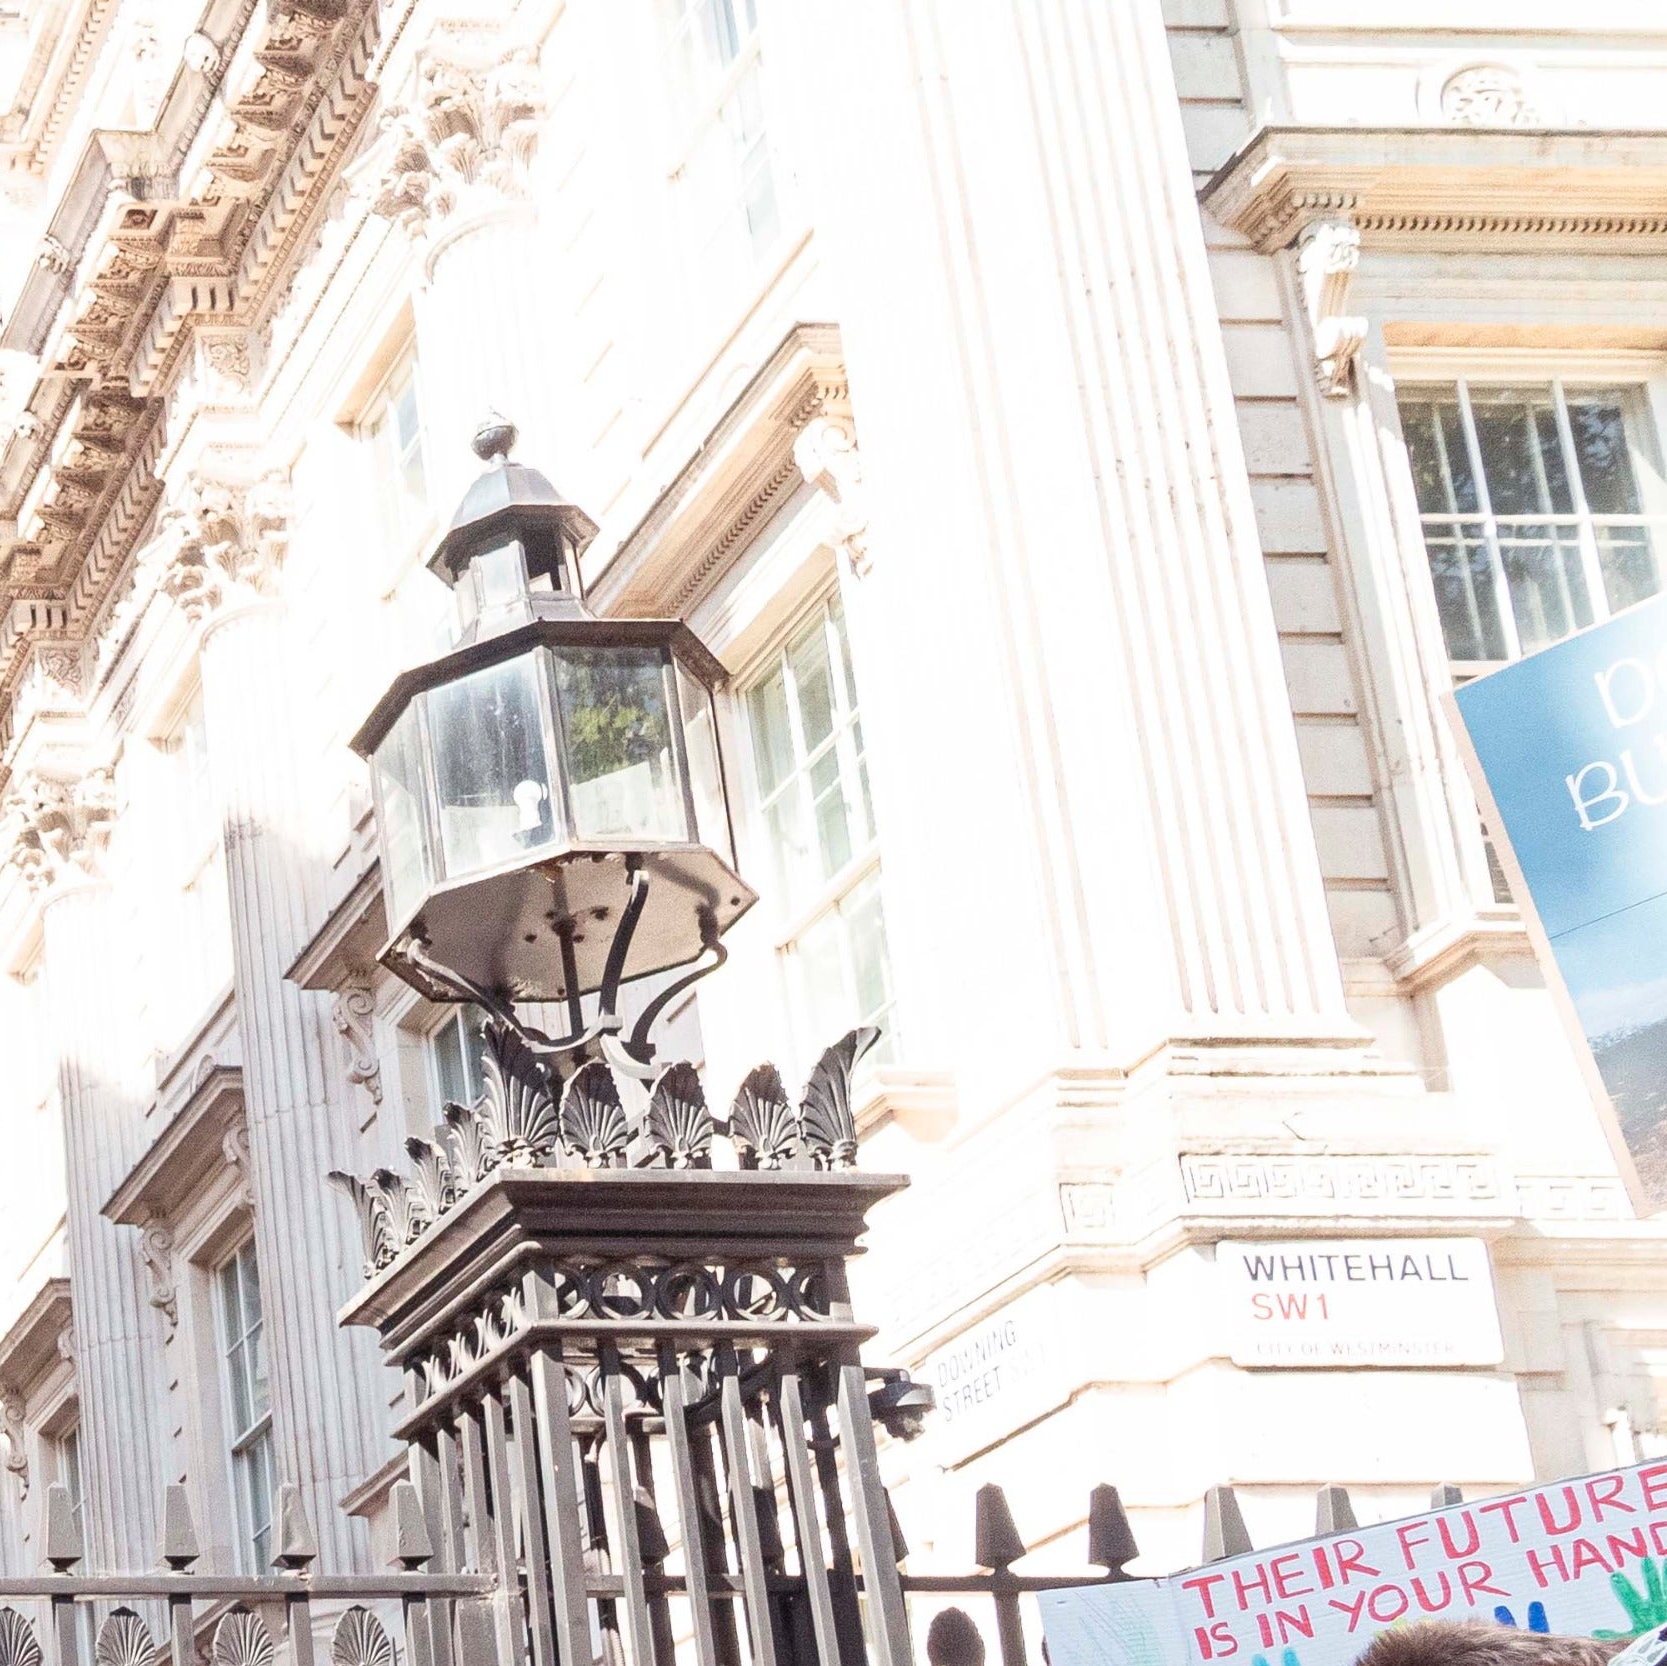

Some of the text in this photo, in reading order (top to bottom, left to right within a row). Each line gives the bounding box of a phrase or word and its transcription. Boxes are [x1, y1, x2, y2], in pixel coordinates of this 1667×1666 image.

[1243, 1254, 1469, 1282] WHITEHALL
[1252, 1292, 1331, 1321] SW1
[937, 1320, 1017, 1388] DOWNING
[1257, 1342, 1455, 1356] CITY OF WESTMINSTER
[942, 1366, 1001, 1422] STREET
[1182, 1540, 1380, 1620] THEIR
[1194, 1619, 1239, 1661] IS
[1257, 1603, 1315, 1649] IN
[1328, 1560, 1512, 1635] YOUR
